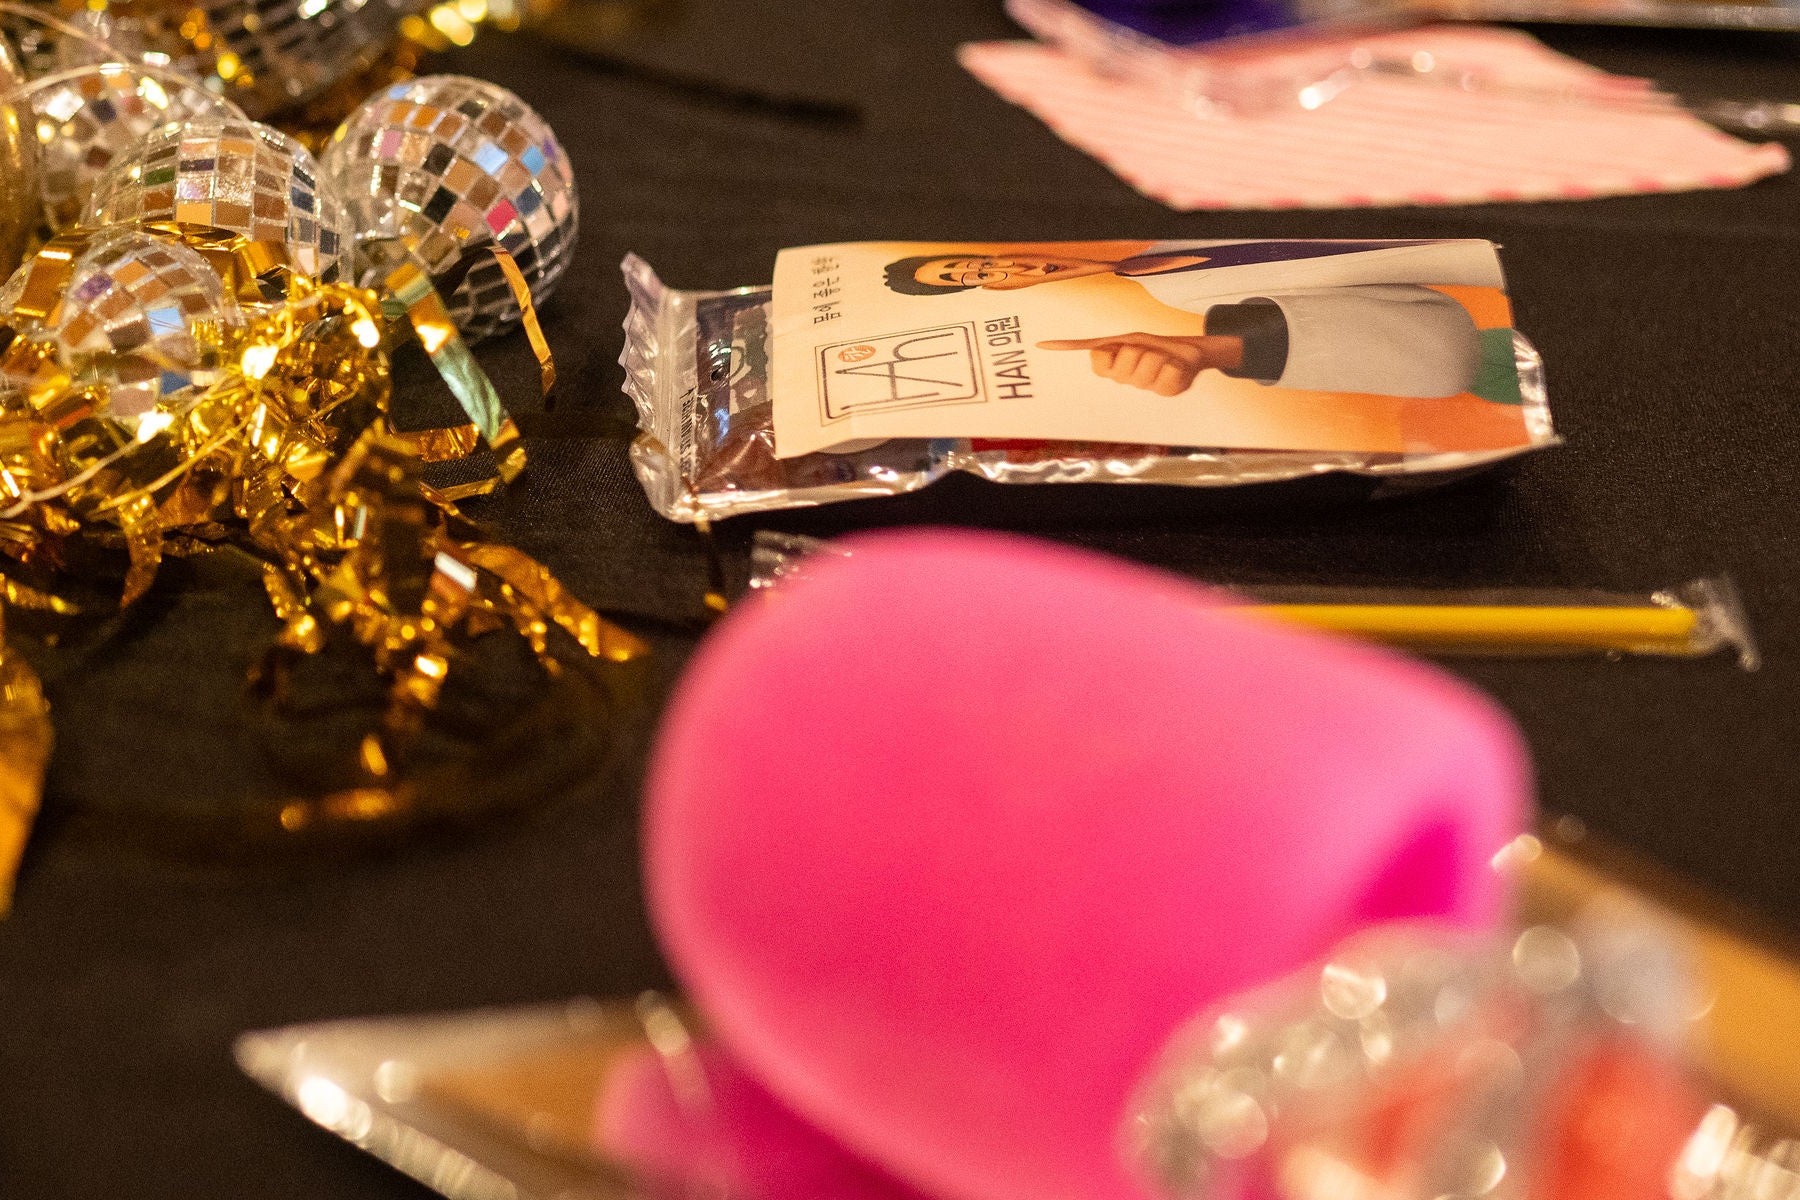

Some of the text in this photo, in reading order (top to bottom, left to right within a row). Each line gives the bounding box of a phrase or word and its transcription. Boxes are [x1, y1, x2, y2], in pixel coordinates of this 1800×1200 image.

[812, 276, 841, 298] 좋은
[813, 301, 841, 324] 몸에
[984, 315, 1033, 400] HAN 의원
